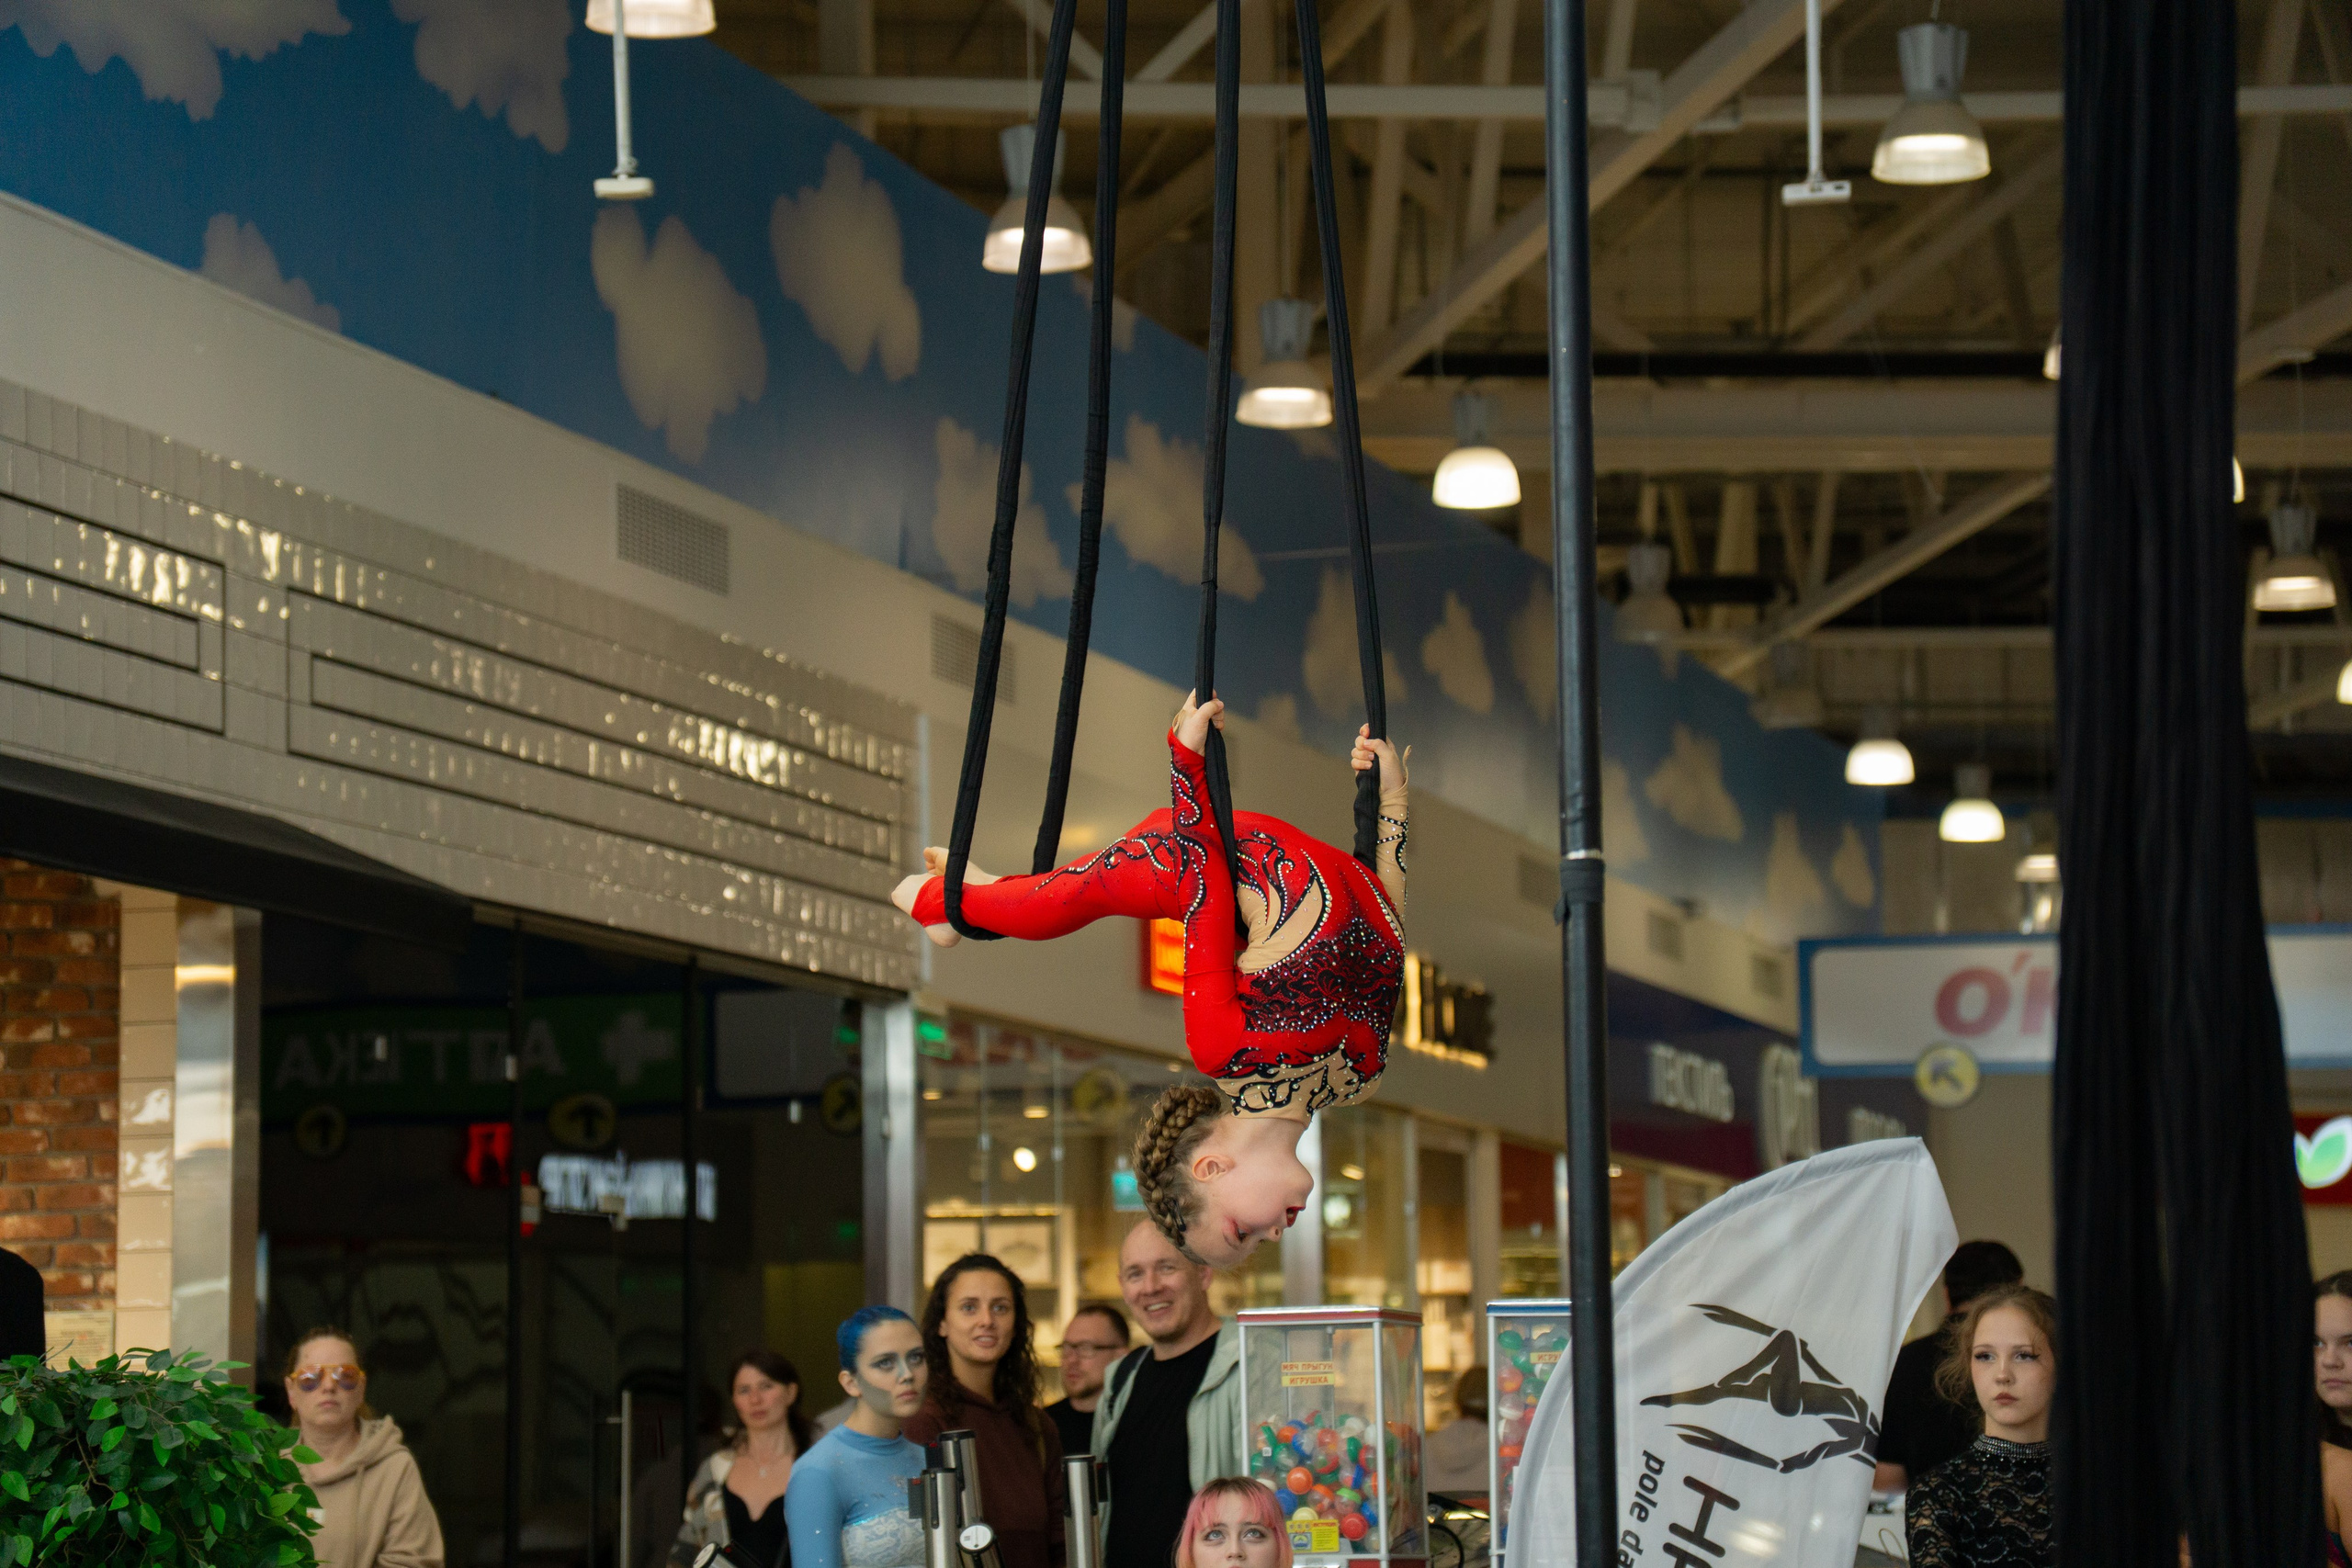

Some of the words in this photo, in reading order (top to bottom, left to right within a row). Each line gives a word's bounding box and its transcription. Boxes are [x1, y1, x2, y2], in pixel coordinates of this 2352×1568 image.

[1282, 1363, 1299, 1371] МЯЧ
[1301, 1362, 1333, 1371] ПРЫГУН
[1289, 1375, 1329, 1385] ИГРУШКА
[1629, 1450, 1666, 1523] pole
[1617, 1529, 1644, 1568] da
